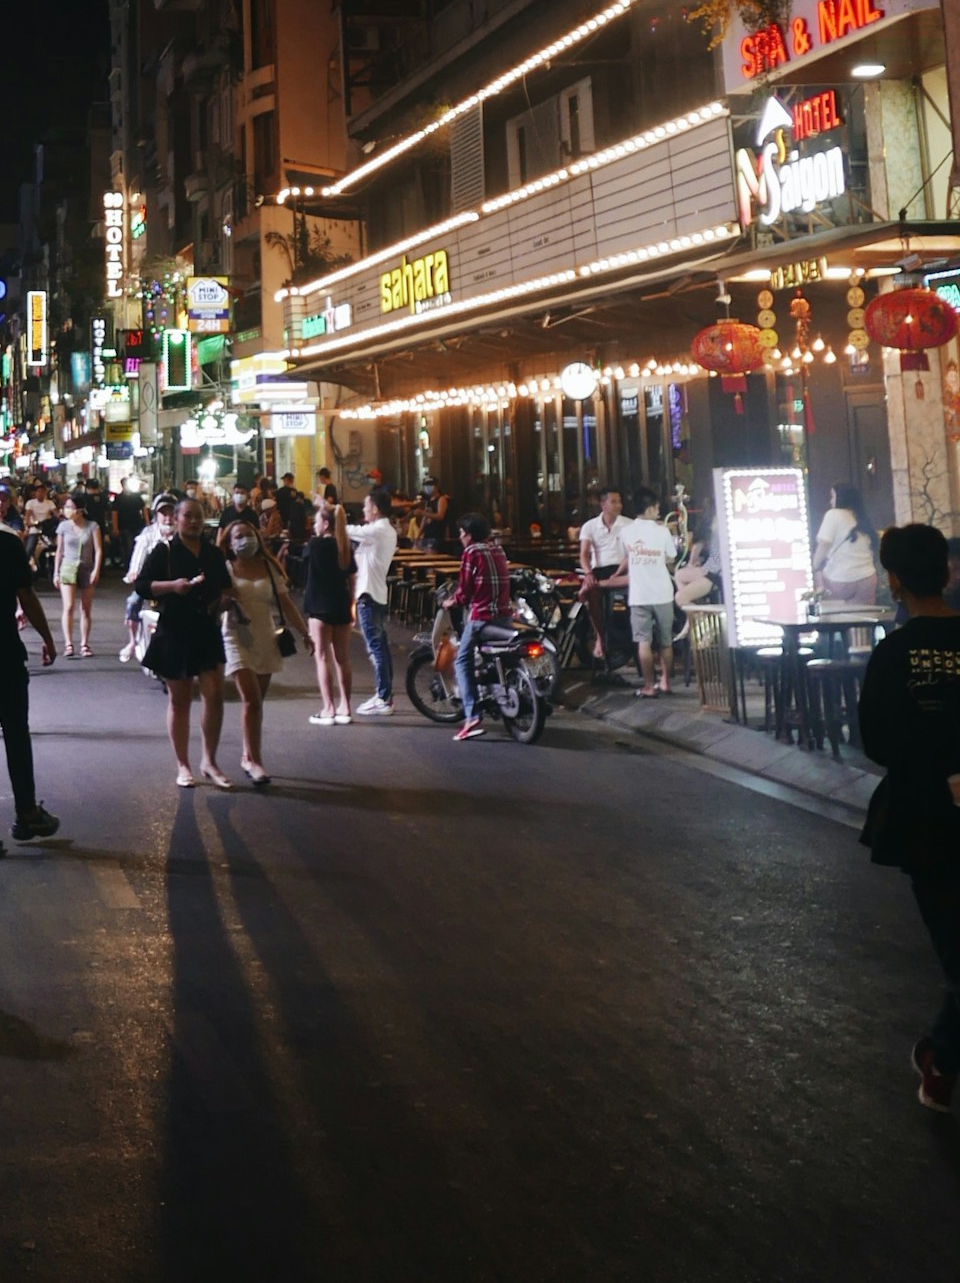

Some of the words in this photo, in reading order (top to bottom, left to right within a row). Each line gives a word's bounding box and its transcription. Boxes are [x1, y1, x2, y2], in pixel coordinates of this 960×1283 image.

[741, 22, 790, 78] SPA
[791, 17, 813, 57] &
[792, 89, 842, 142] HOTEL
[105, 209, 124, 297] HOTEL
[198, 293, 220, 301] STOP
[380, 250, 450, 316] sahara
[93, 319, 106, 365] HOTEL
[197, 319, 221, 331] 24H
